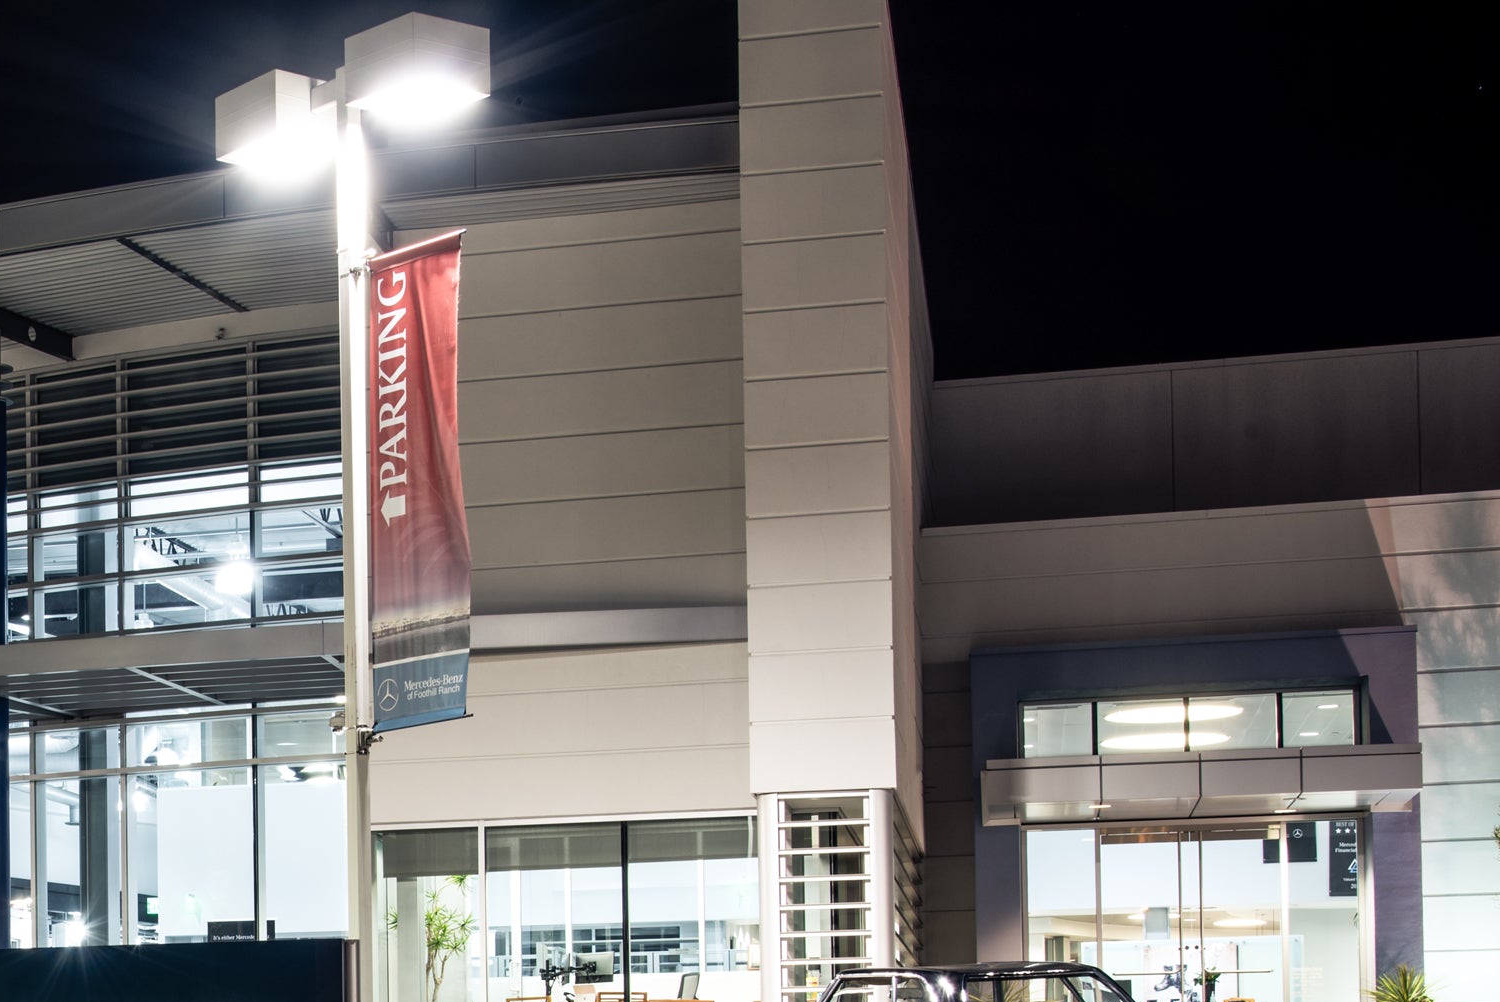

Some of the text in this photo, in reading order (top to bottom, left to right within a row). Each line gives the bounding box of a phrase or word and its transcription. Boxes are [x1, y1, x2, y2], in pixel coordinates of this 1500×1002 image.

[377, 270, 407, 491] PARKING
[403, 674, 464, 692] Mercedes-Benz
[407, 684, 460, 701] of Foothill Ranch
